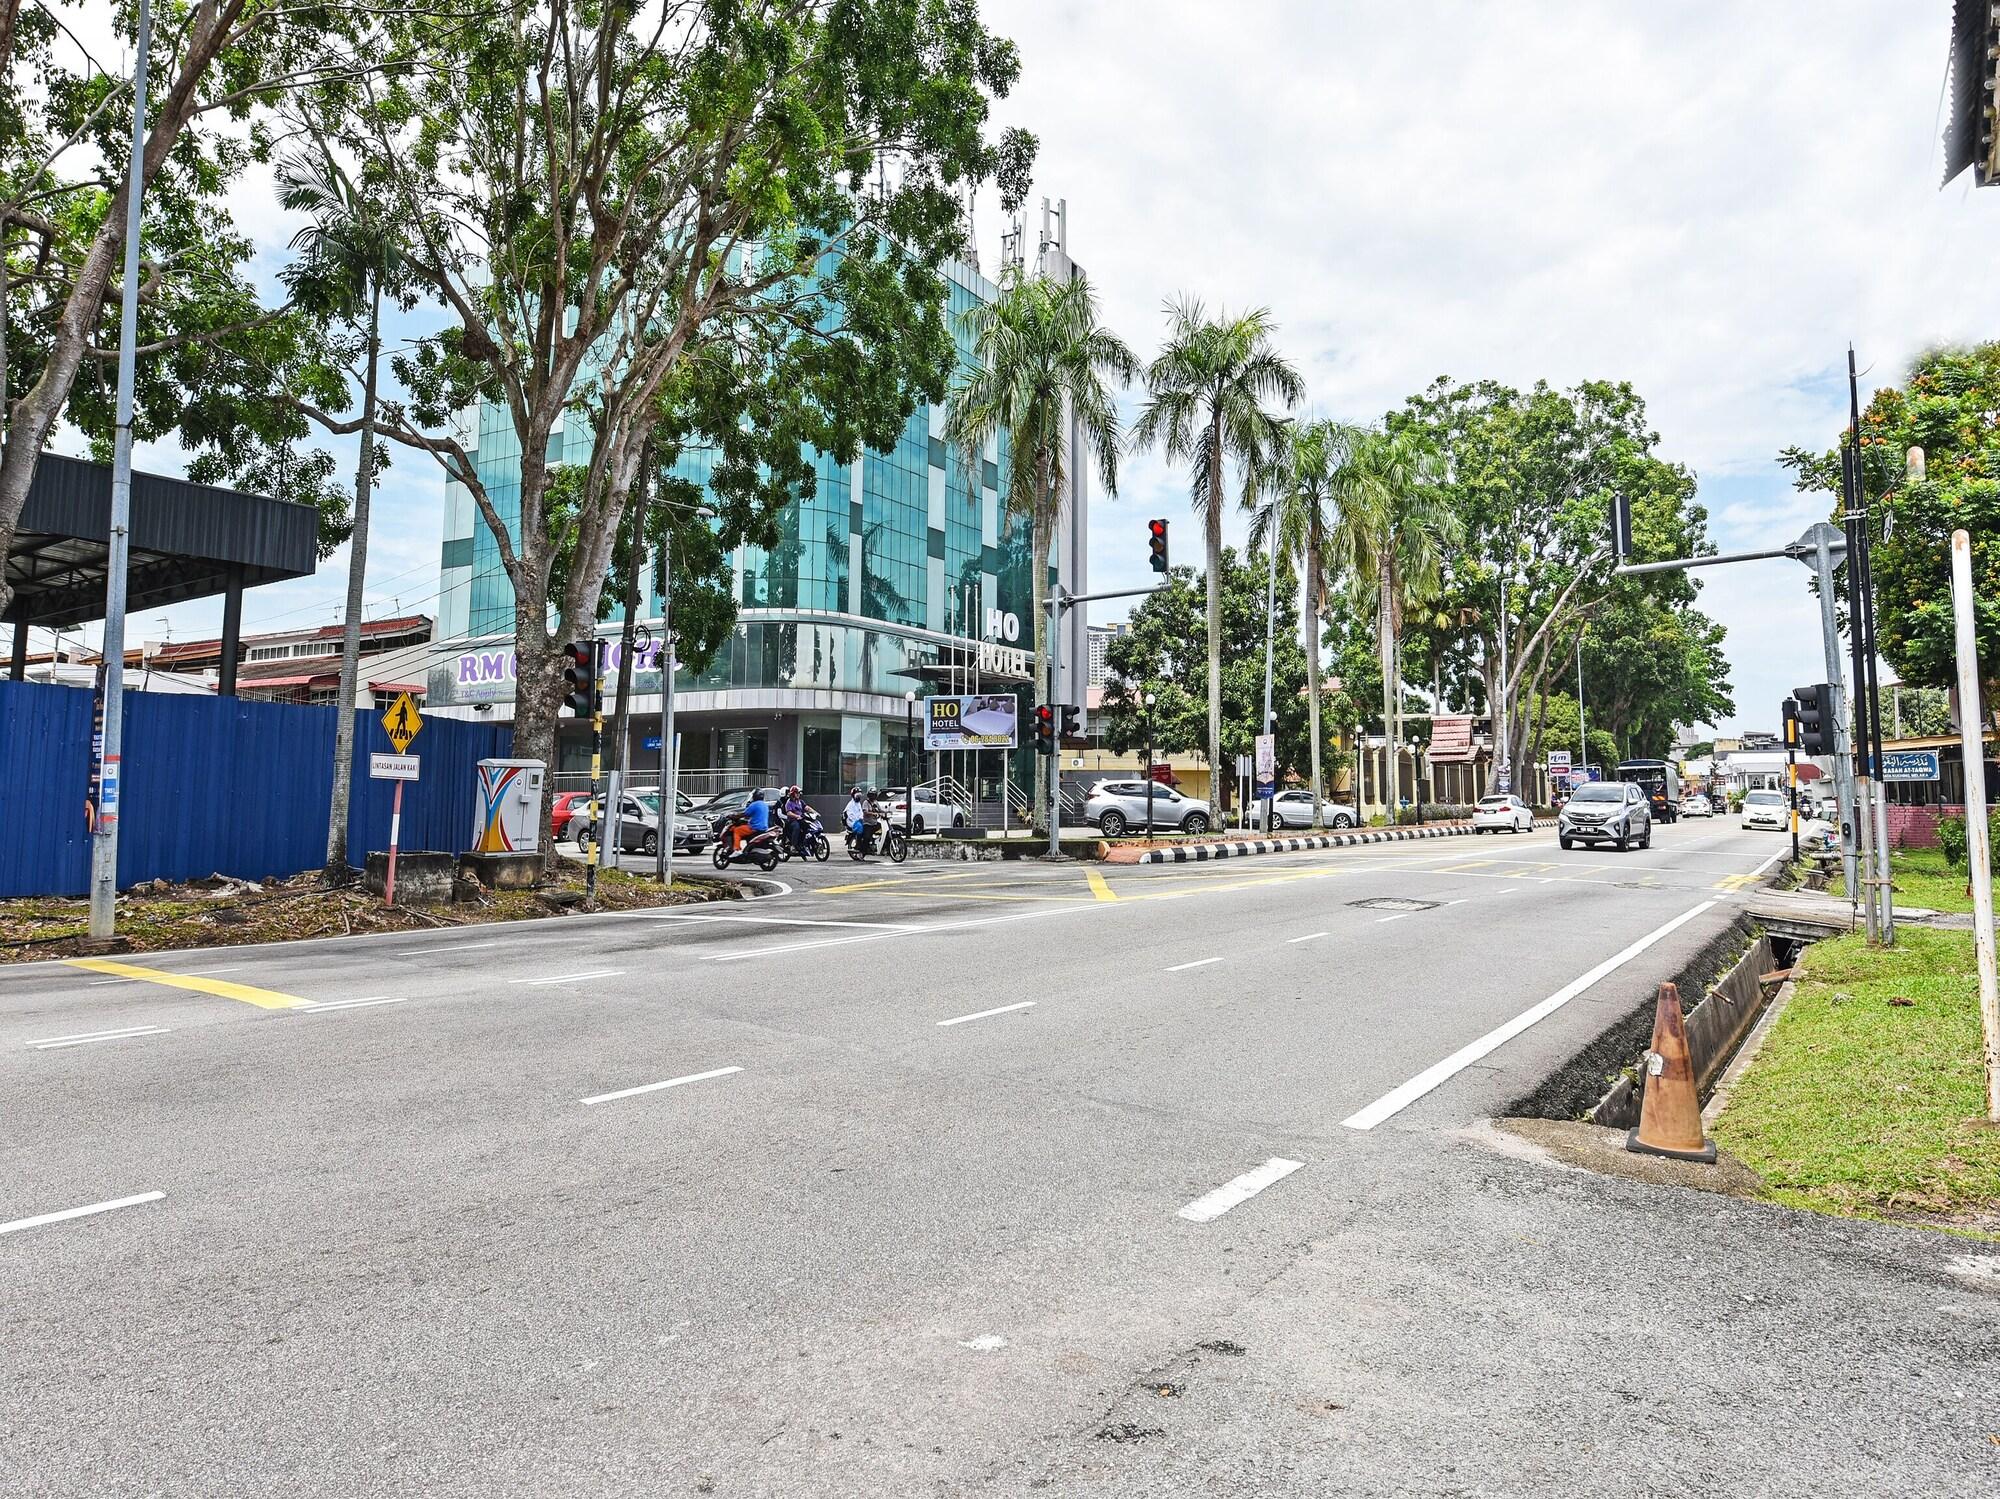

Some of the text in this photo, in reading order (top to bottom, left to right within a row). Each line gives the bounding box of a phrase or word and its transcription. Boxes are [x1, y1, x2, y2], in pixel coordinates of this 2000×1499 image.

[987, 608, 1020, 642] HO
[459, 654, 504, 682] RM
[980, 642, 1030, 678] HOTEL
[933, 703, 958, 718] HO
[373, 762, 392, 770] LINTASAN
[393, 763, 407, 771] JALAN
